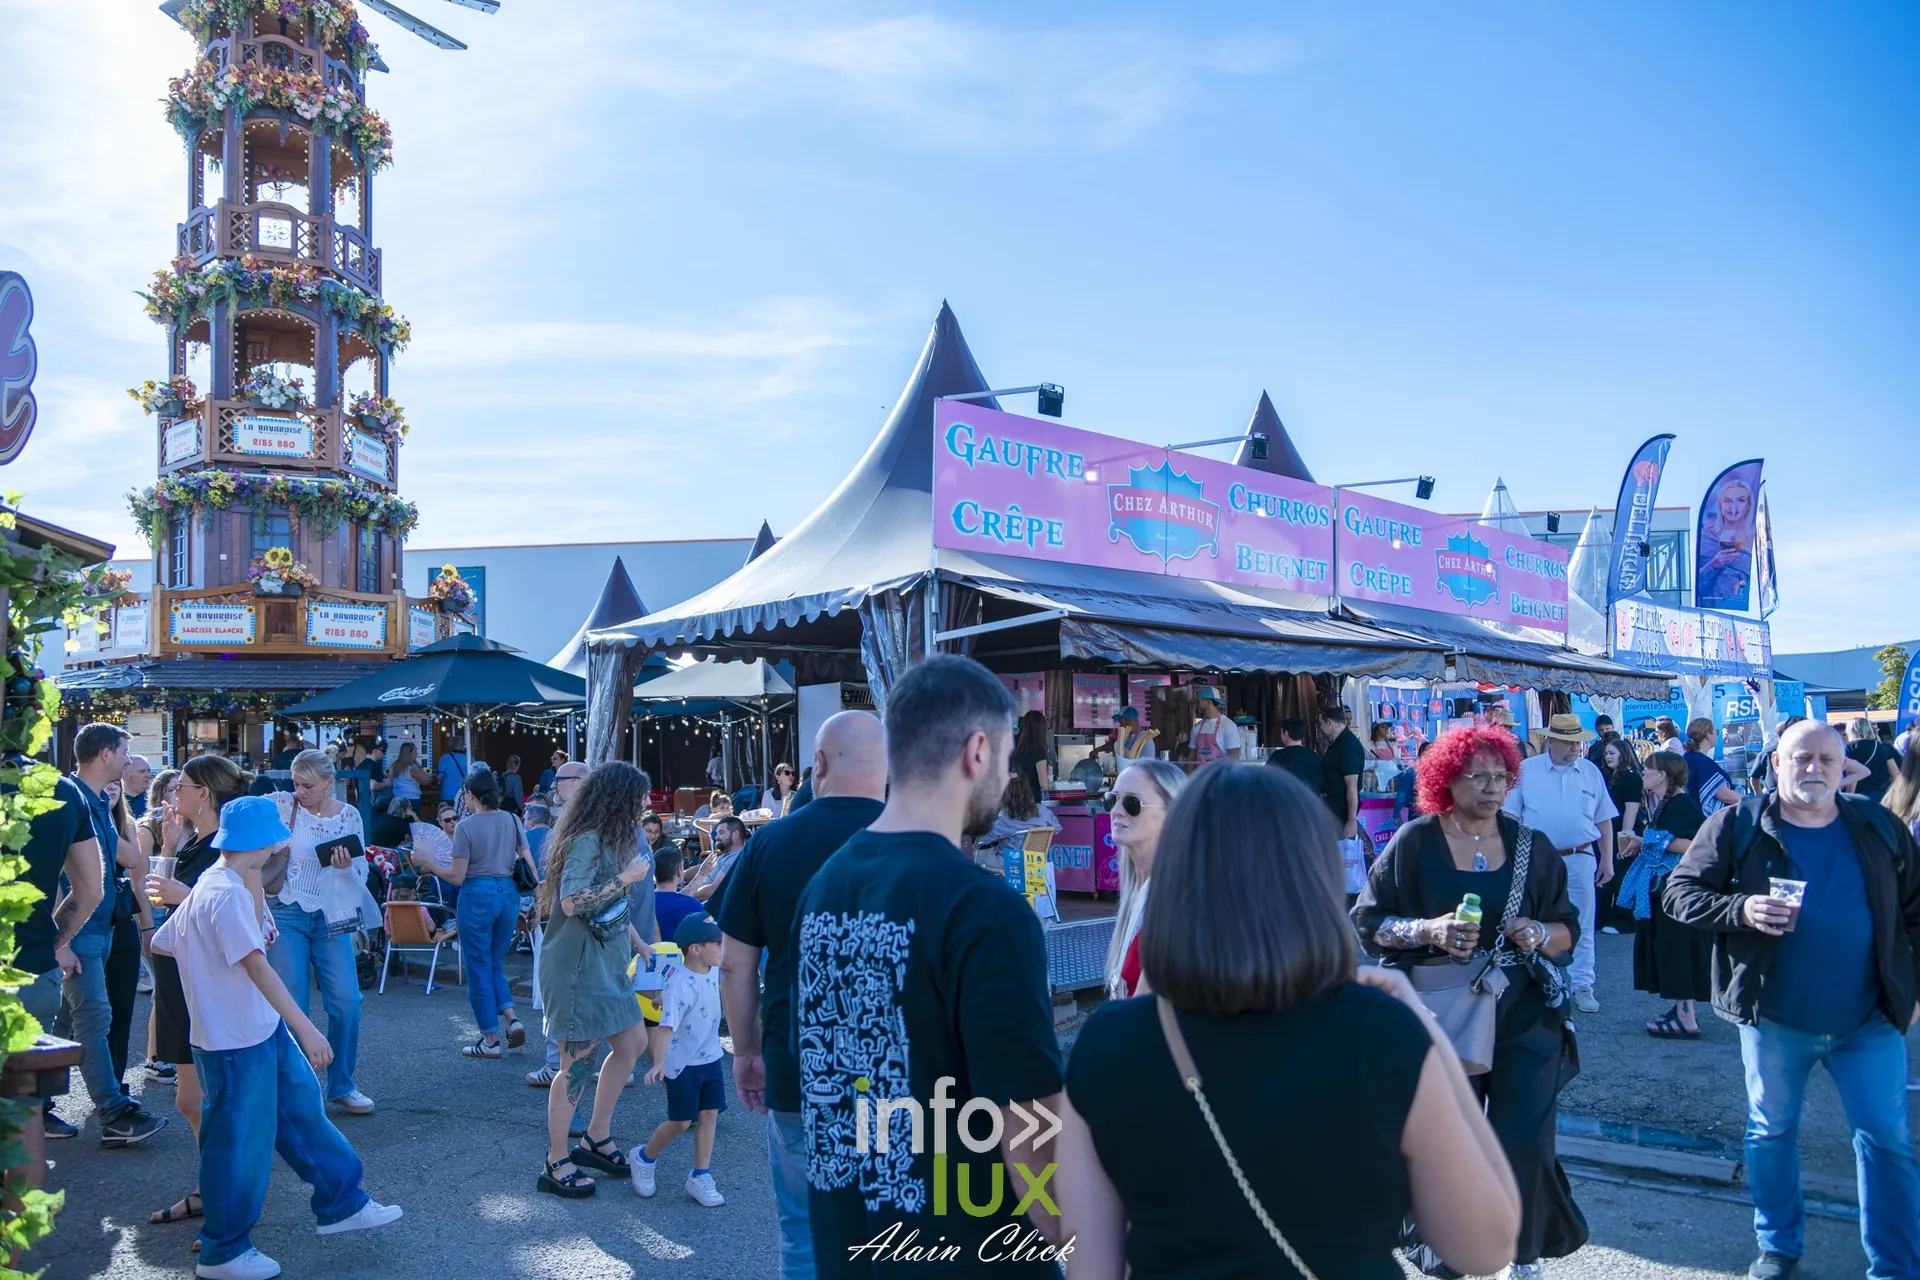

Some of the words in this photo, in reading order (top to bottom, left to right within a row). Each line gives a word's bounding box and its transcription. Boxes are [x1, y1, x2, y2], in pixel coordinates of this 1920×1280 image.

[253, 438, 273, 447] RIBS
[277, 440, 295, 449] BBQ
[944, 423, 1084, 482] GAUFRE
[1113, 492, 1152, 513] CHEZ
[1158, 494, 1214, 529] ARTHUR
[1229, 483, 1330, 528] CHURROS
[952, 501, 1064, 548] CRÊPE
[1344, 506, 1422, 546] GAUFRE
[1236, 544, 1328, 582] BEIGNET
[1350, 562, 1412, 596] CRÊPE
[1438, 555, 1462, 570] CHEZ
[1505, 546, 1566, 580] CHURROS
[196, 612, 243, 620] BAVAROISE
[333, 612, 376, 622] BAVAROISE
[1510, 593, 1565, 623] BEIGNET
[325, 628, 345, 637] RIBS
[350, 629, 368, 639] BBQ
